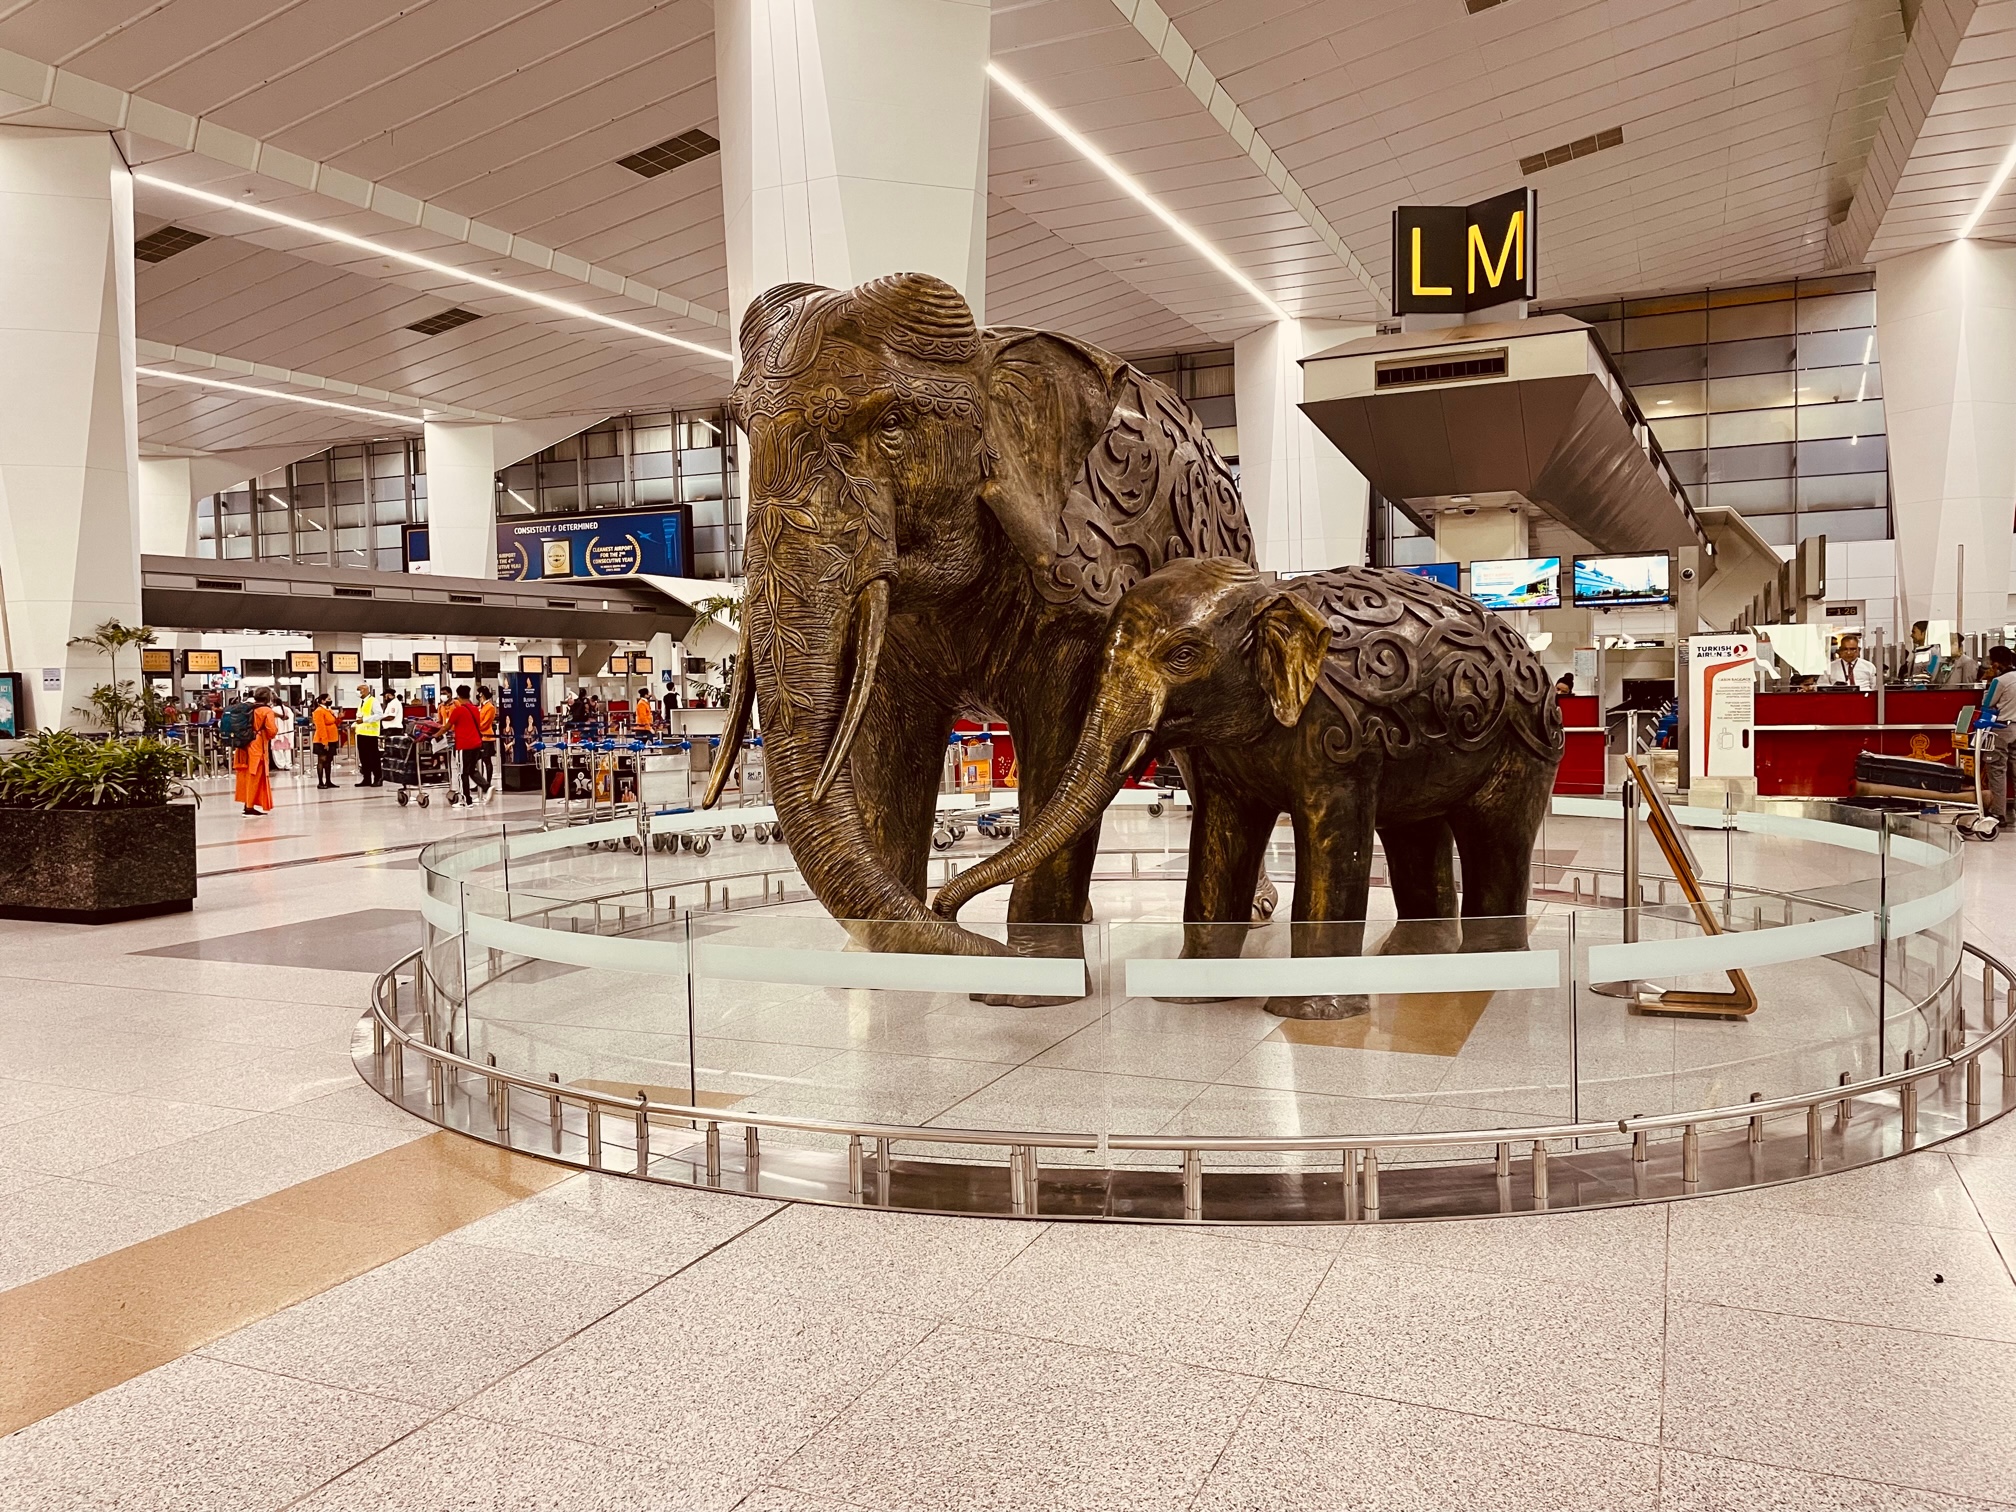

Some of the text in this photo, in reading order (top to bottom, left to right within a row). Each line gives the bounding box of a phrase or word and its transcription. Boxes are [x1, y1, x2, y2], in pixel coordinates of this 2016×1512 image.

[1412, 227, 1453, 296] L
[1468, 210, 1524, 294] M
[514, 525, 551, 534] CONSISTENT
[558, 522, 598, 532] DETERMINED
